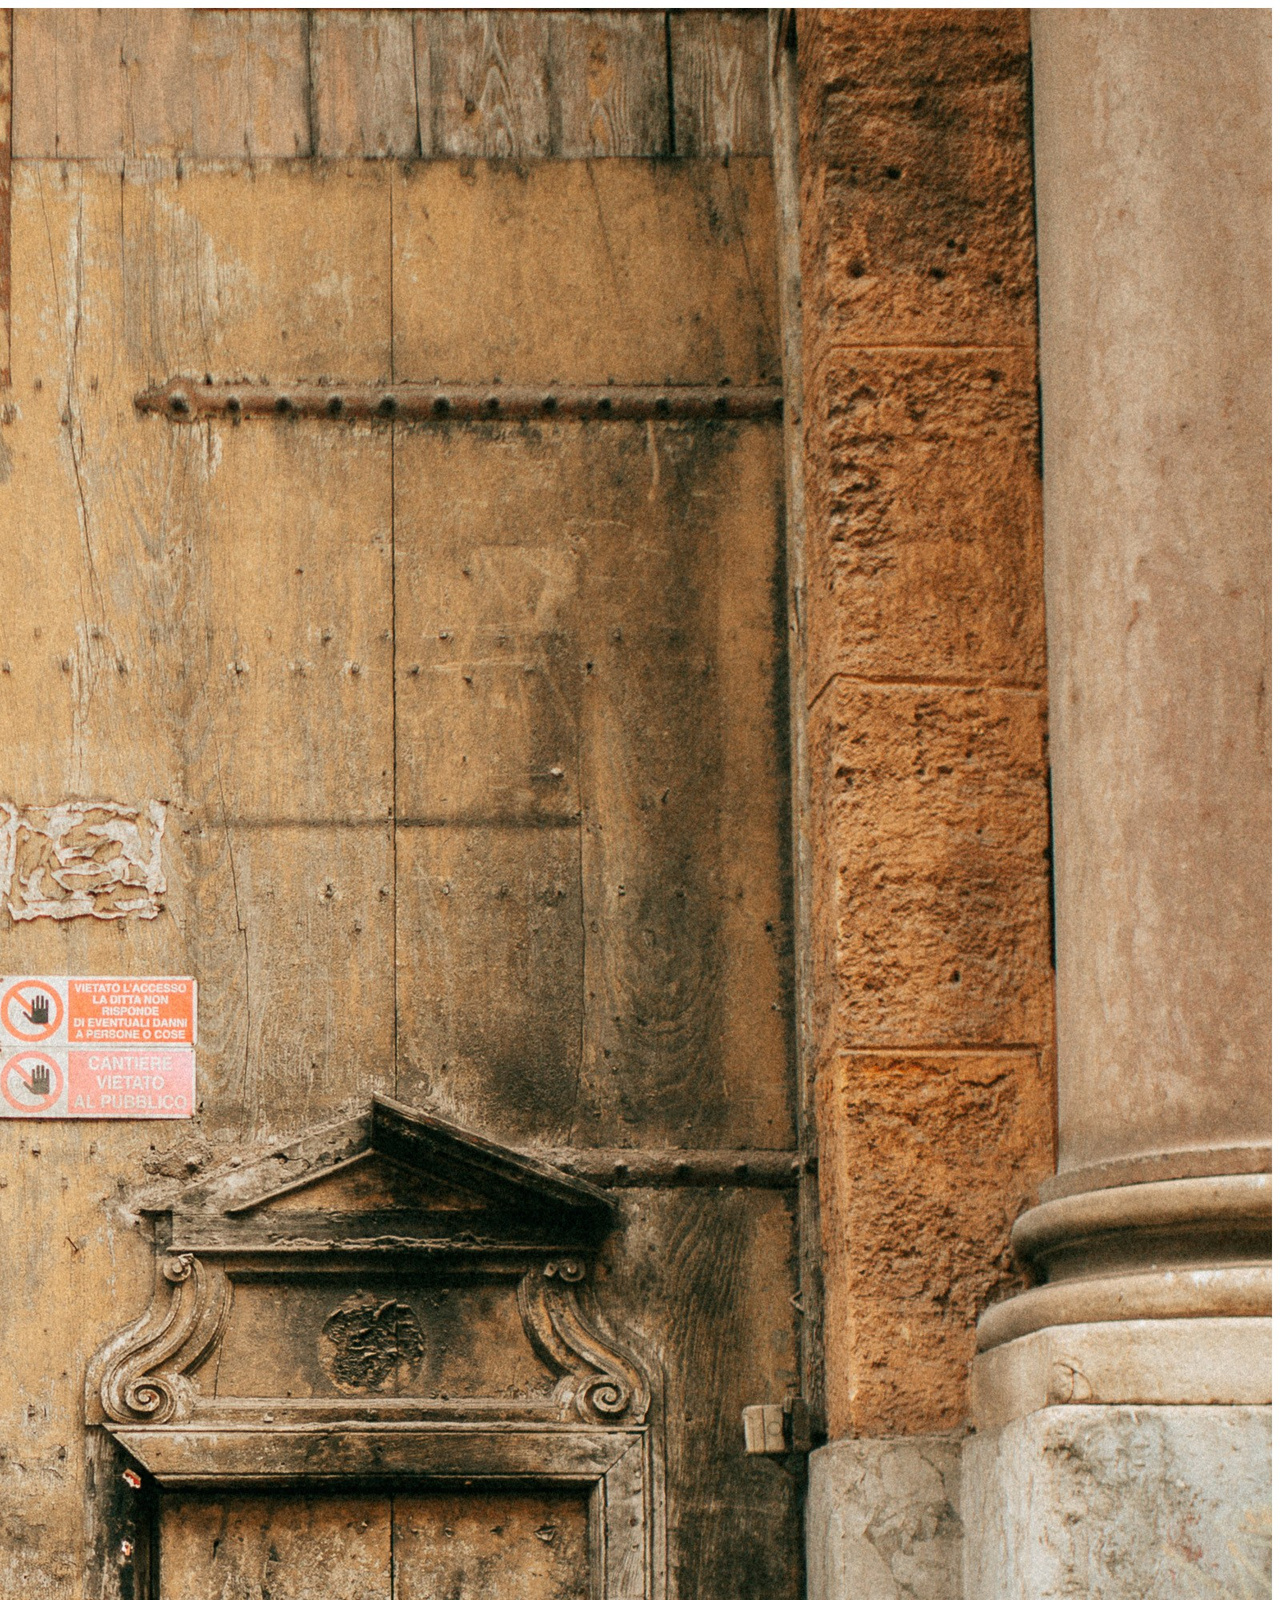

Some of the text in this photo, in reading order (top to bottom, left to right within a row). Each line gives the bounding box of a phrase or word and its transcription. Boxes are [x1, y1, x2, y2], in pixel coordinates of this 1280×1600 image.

[74, 983, 187, 993] VIETATO L'ACCESSO
[92, 995, 169, 1004] LA DITTA NON
[102, 1006, 159, 1016] RISPONDE
[73, 1018, 187, 1027] DI EVENTUALI DANNI
[75, 1029, 186, 1039] A PERSONE O COSE
[88, 1055, 173, 1071] CANTIERE
[96, 1075, 165, 1090] VIETATO
[74, 1094, 188, 1109] AL PUBBLICO
